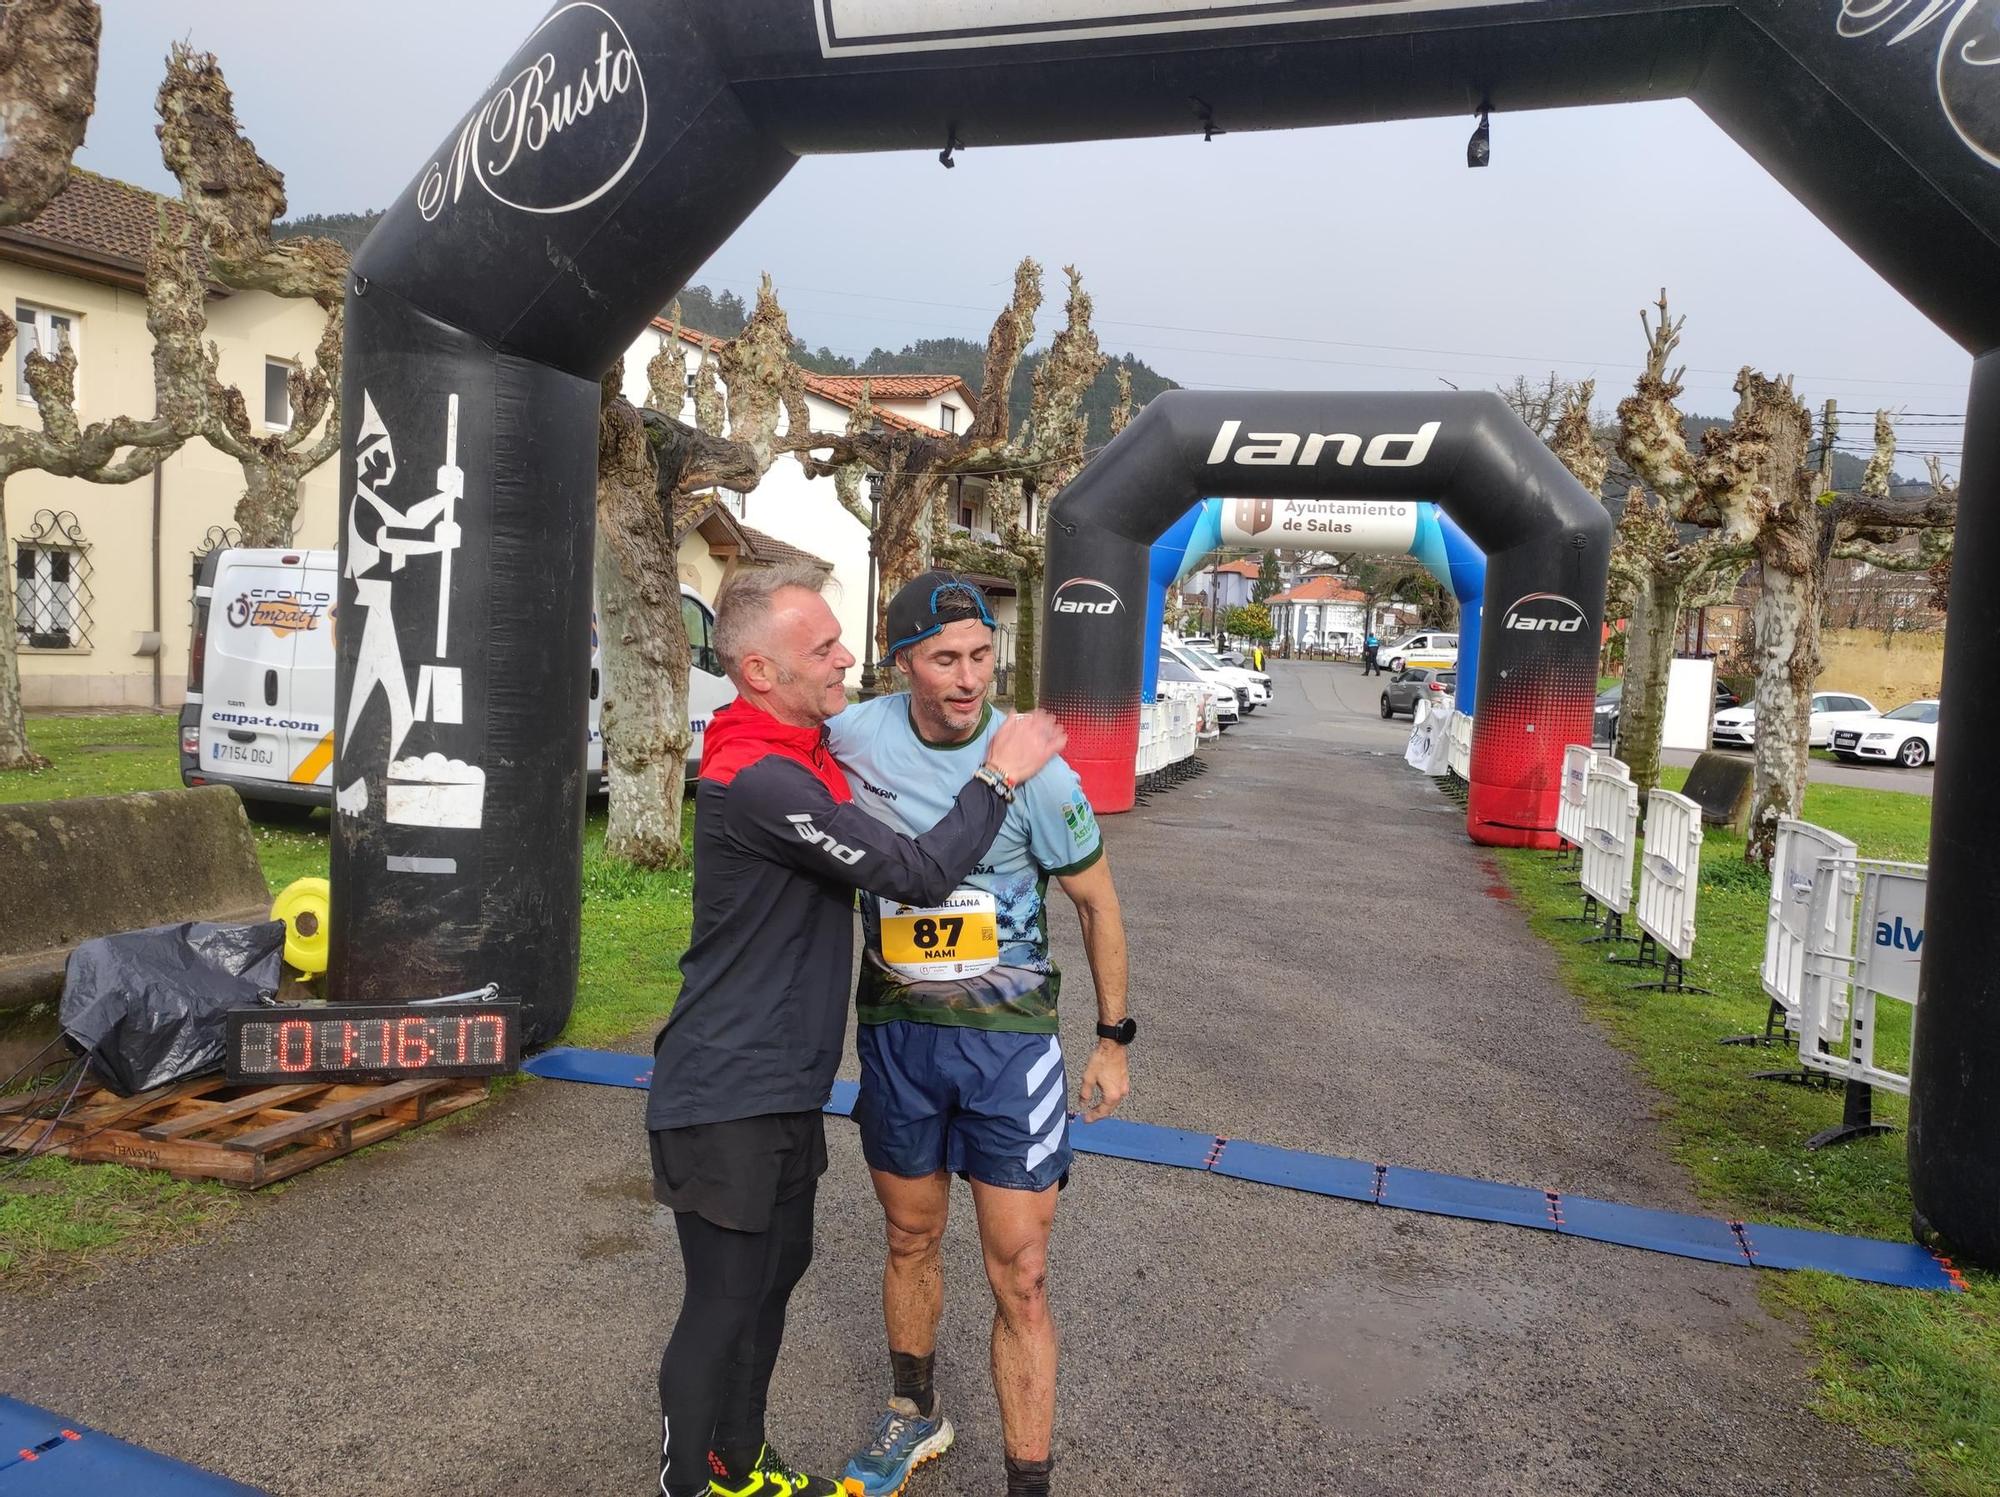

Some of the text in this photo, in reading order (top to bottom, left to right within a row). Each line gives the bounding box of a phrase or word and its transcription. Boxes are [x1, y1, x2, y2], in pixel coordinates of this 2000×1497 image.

[1206, 419, 1442, 467] land
[1285, 501, 1407, 517] Ayuntamiento
[1283, 518, 1352, 533] de Salas
[1053, 597, 1118, 615] land
[1506, 613, 1583, 632] land
[211, 711, 320, 732] empa-t.com
[220, 744, 273, 765] 7154 DGJ
[913, 916, 964, 949] 87
[924, 949, 956, 959] NAMI
[279, 1014, 505, 1073] 01:16:17
